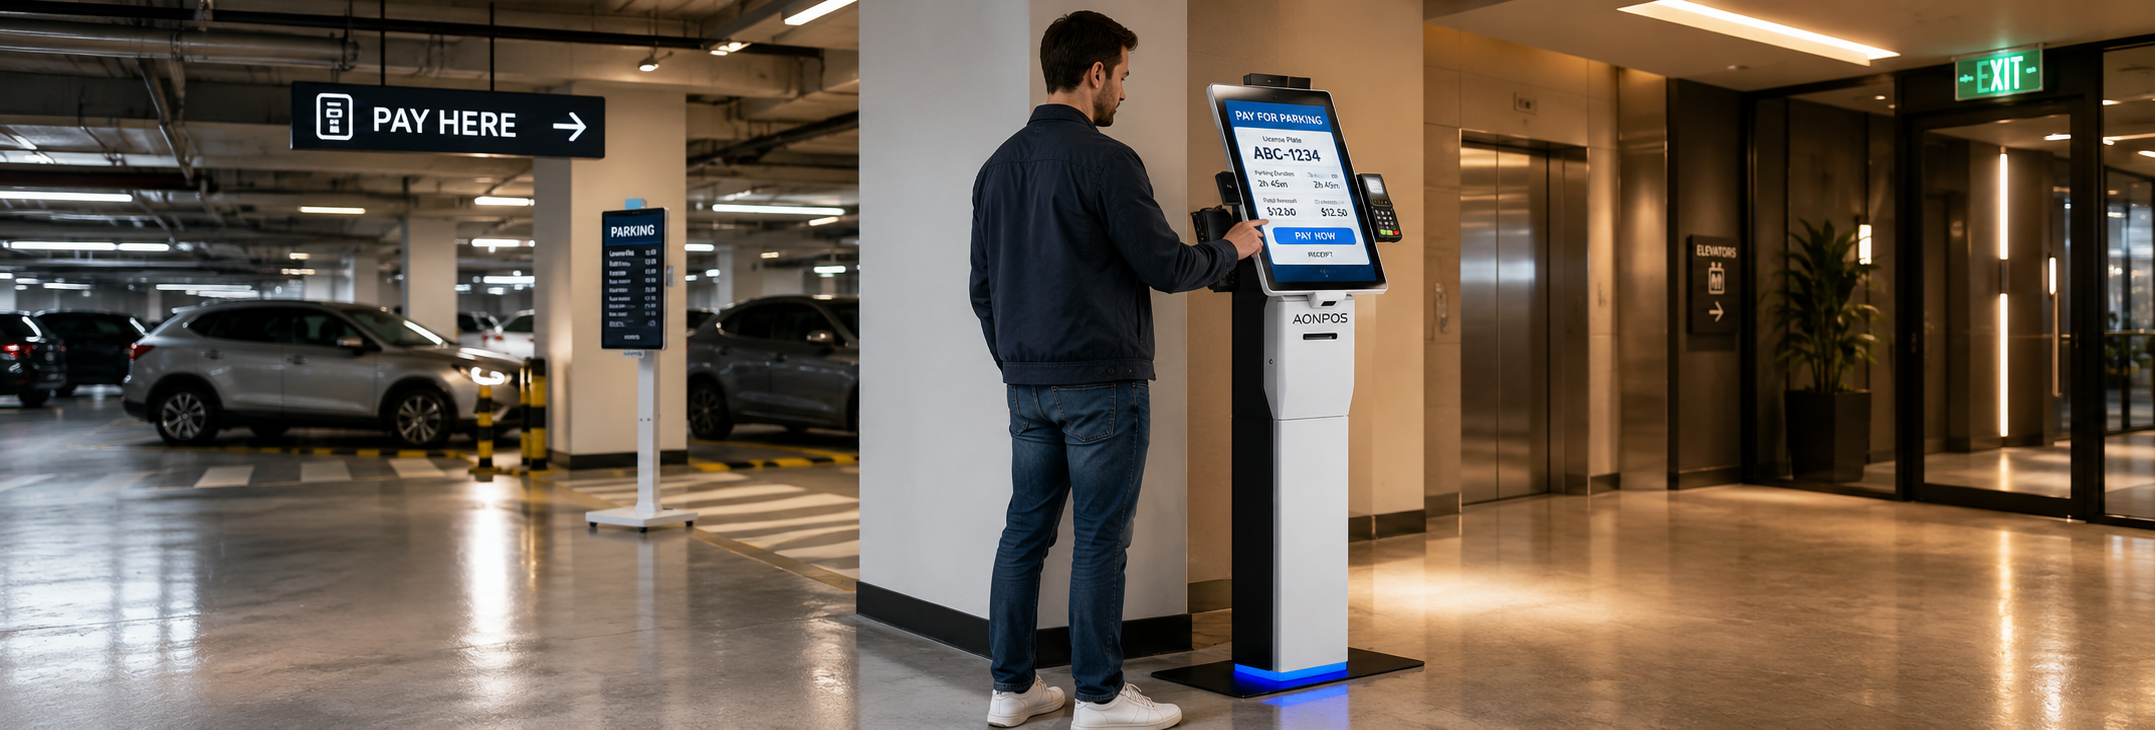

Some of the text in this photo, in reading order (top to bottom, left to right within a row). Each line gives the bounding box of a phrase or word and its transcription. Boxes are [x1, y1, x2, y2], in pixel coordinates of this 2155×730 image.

[1977, 56, 2023, 93] EXIT
[373, 107, 516, 137] PAY HERE
[1235, 110, 1323, 125] PAY FOR PARKING
[1254, 146, 1321, 161] ABC-1234
[1258, 180, 1268, 188] 2h
[611, 224, 655, 237] PARKING
[1295, 232, 1335, 240] PAY NOW
[1696, 244, 1737, 258] ELEVATORS
[1293, 313, 1348, 324] AONPOS
